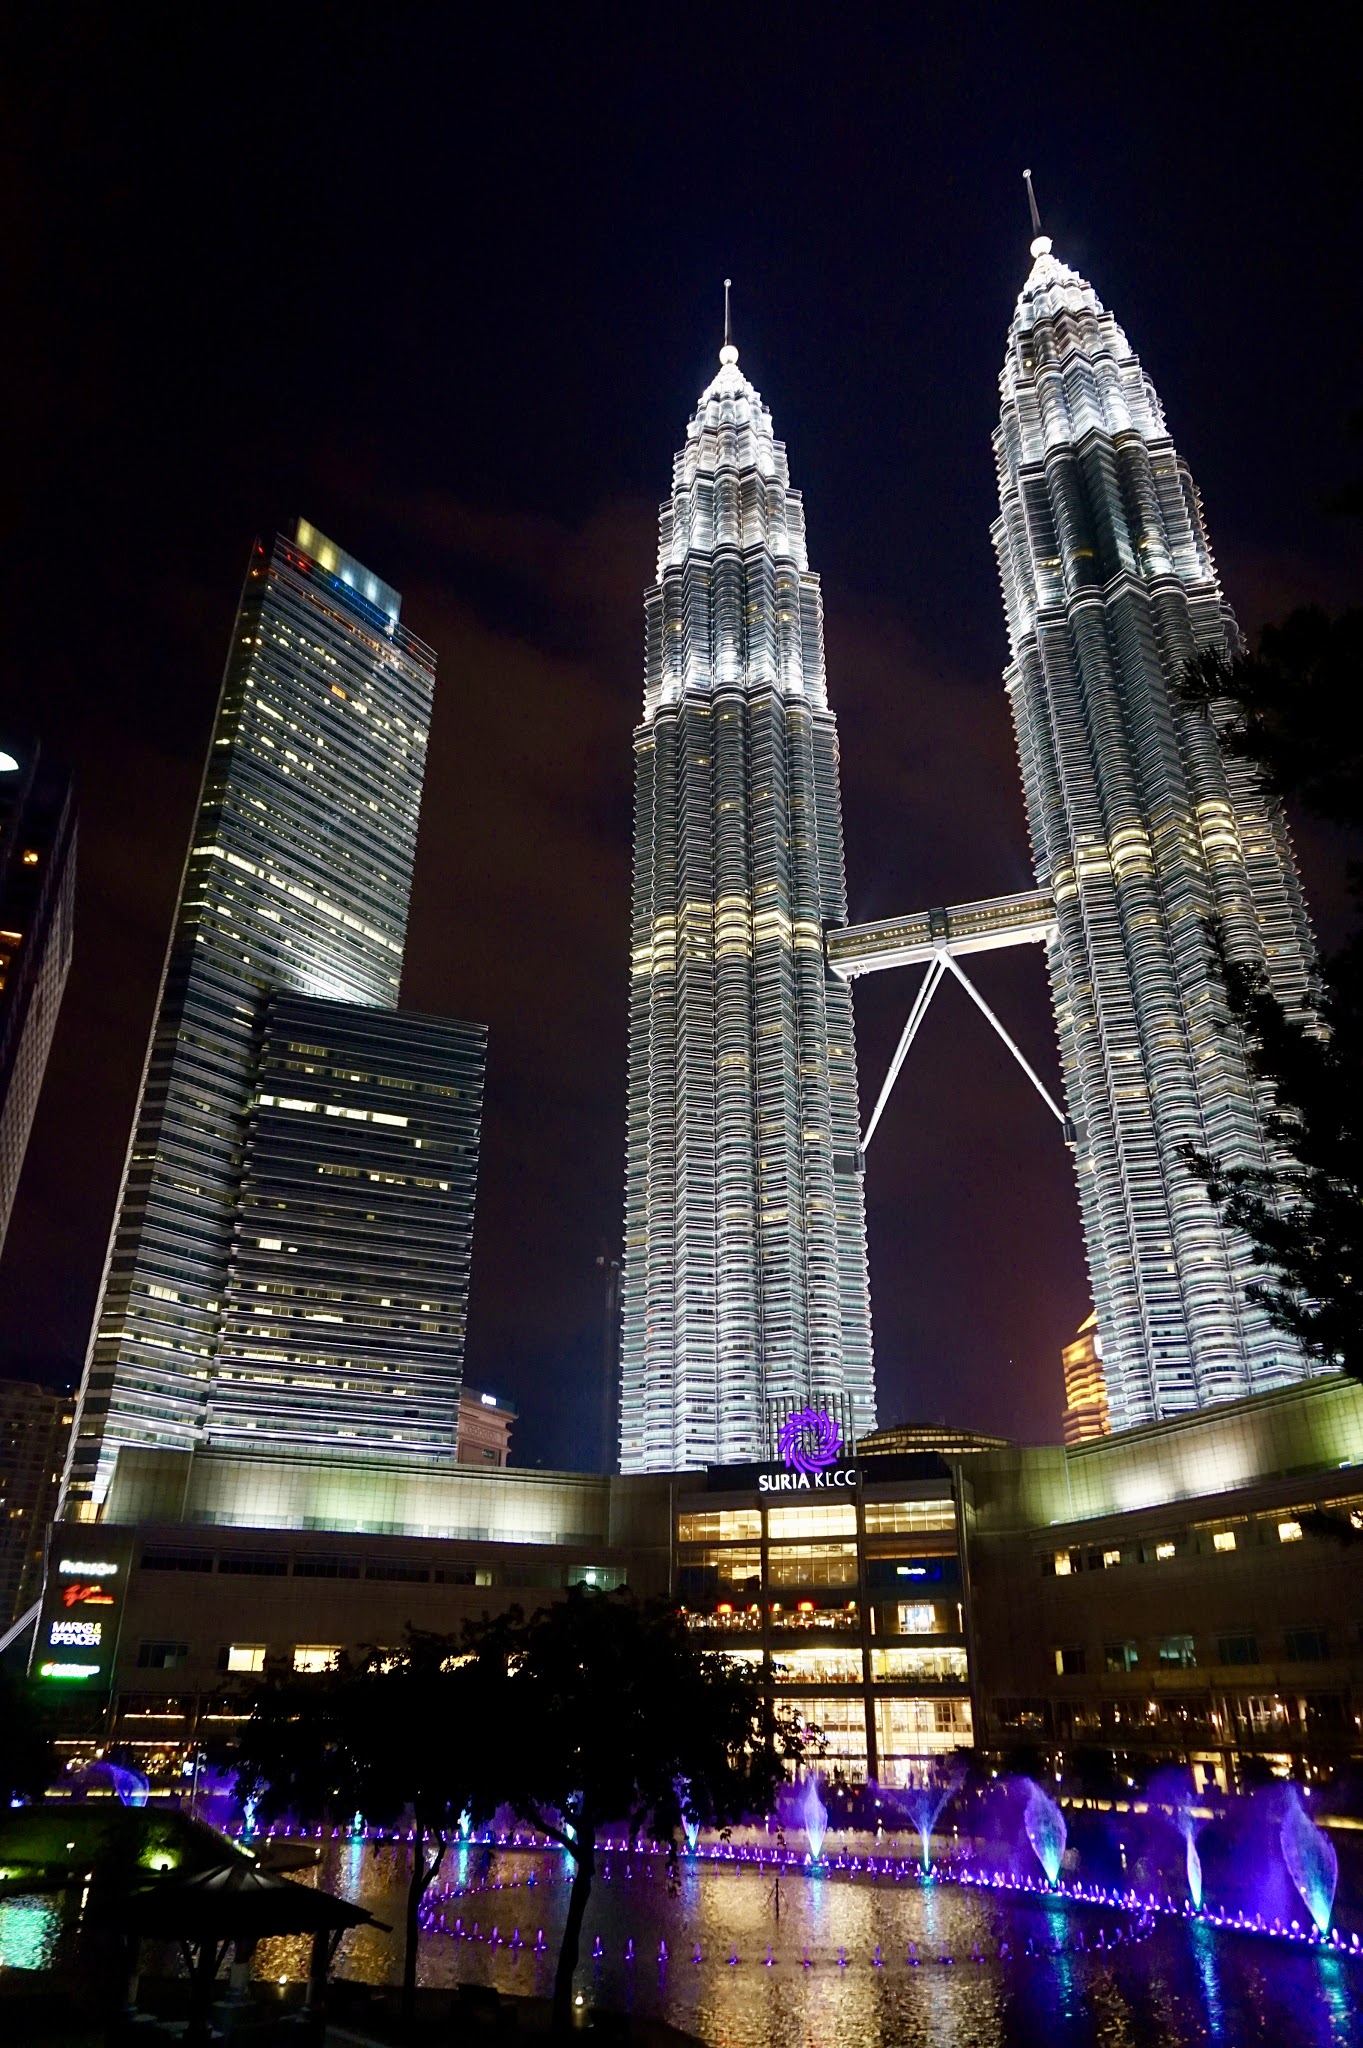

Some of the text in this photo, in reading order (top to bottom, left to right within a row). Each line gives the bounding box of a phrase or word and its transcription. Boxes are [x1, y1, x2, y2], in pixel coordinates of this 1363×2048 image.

[759, 1469, 857, 1492] SURIA KLCC
[50, 1633, 102, 1645] SPENCER
